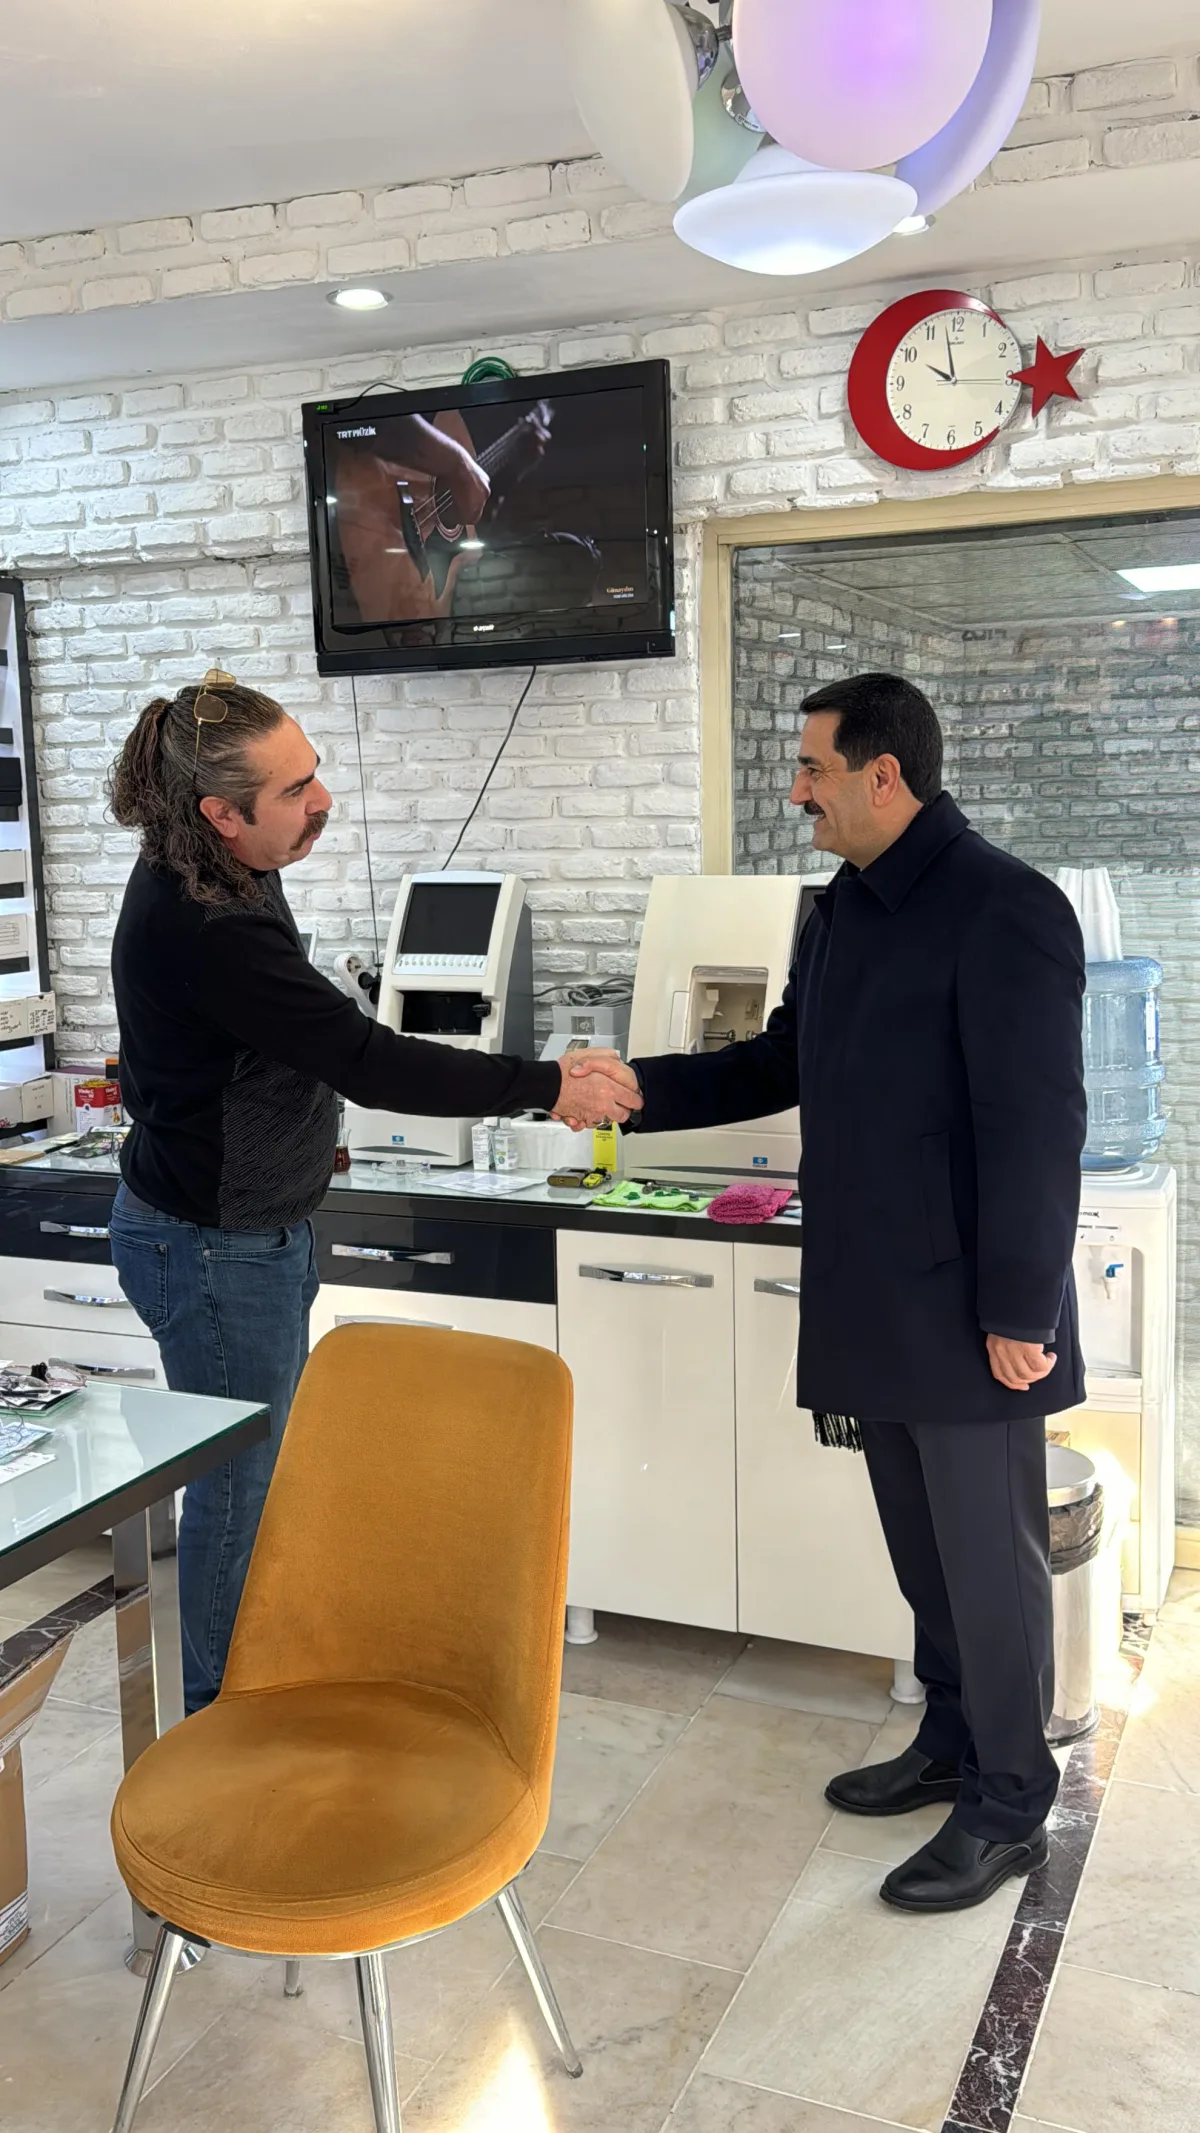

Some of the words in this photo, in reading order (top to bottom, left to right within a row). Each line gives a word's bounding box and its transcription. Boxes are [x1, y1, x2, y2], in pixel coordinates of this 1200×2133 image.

[952, 316, 965, 332] 12
[982, 322, 987, 338] 1
[926, 325, 935, 341] 11
[904, 346, 918, 363] 10
[998, 342, 1007, 358] 2
[896, 375, 905, 391] 9
[1005, 370, 1014, 386] 3
[902, 404, 912, 420] 8
[994, 400, 1003, 416] 4
[337, 430, 352, 439] TRT
[921, 423, 930, 439] 7
[947, 429, 956, 445] 6
[974, 421, 983, 437] 5
